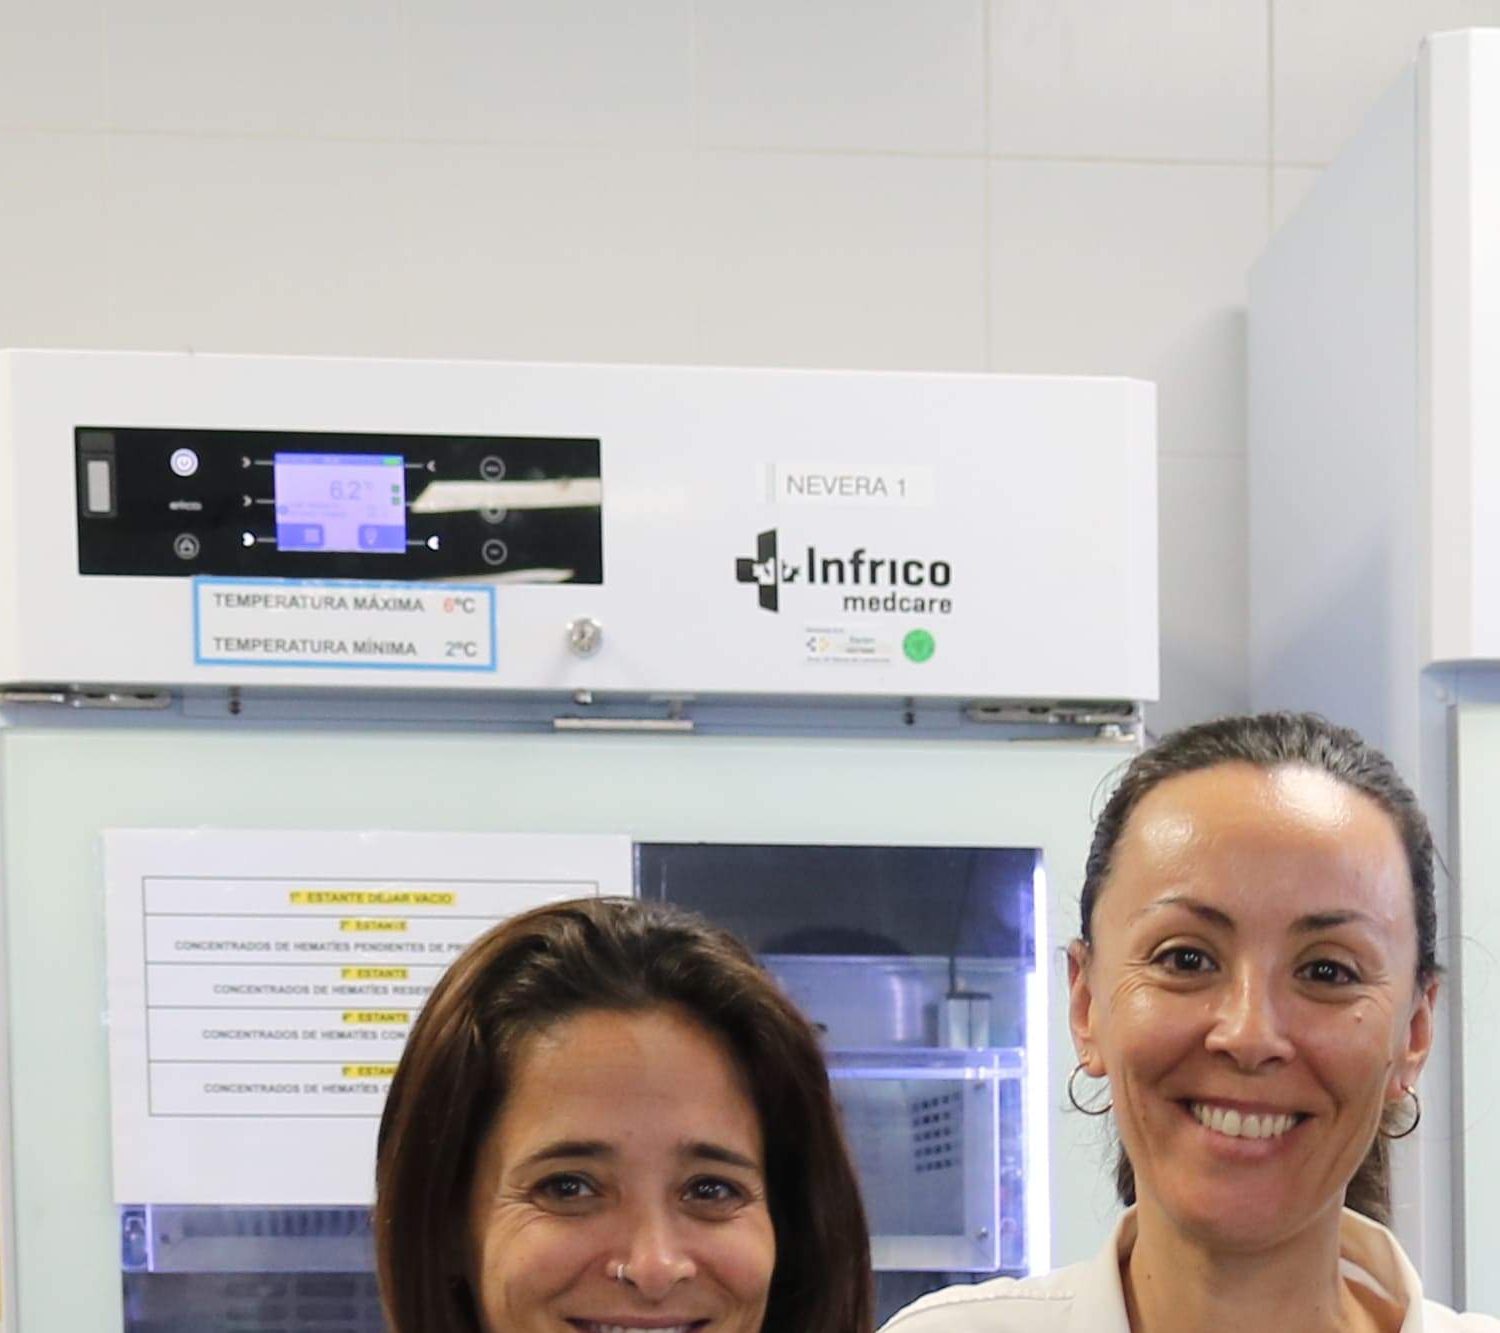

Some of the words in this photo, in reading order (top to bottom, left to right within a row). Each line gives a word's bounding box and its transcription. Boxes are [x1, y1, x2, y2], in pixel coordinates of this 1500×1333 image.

[786, 474, 889, 497] NEVERA
[898, 478, 907, 497] 1
[806, 546, 952, 587] Infrico
[213, 593, 348, 612] TEMPERATURA
[353, 592, 425, 613] MÁXIMA
[843, 591, 952, 613] medcare
[213, 637, 348, 655] TEMPERATURA
[353, 636, 417, 656] MÍNIMA
[307, 892, 363, 904] ESTANTE
[368, 893, 411, 904] DEJAR
[414, 894, 452, 905] VACIO
[175, 940, 271, 952] CONCENTRADOS
[275, 940, 291, 952] DE
[293, 939, 350, 953] HEMATÍES
[354, 941, 426, 953] PENDIENTES
[429, 942, 444, 954] DE
[357, 968, 408, 979] ESTANTE
[213, 984, 310, 995] CONCENTRADOS
[314, 984, 328, 995] DE
[332, 983, 389, 996] HEMATÍES
[358, 1012, 409, 1023] ESTANTE
[202, 1029, 299, 1041] CONCENTRADOS
[302, 1029, 316, 1041] DE
[321, 1028, 378, 1041] HEMATÍES
[204, 1083, 300, 1095] CONCENTRADOS
[303, 1083, 318, 1095] DE
[322, 1082, 378, 1095] HEMATÍES
